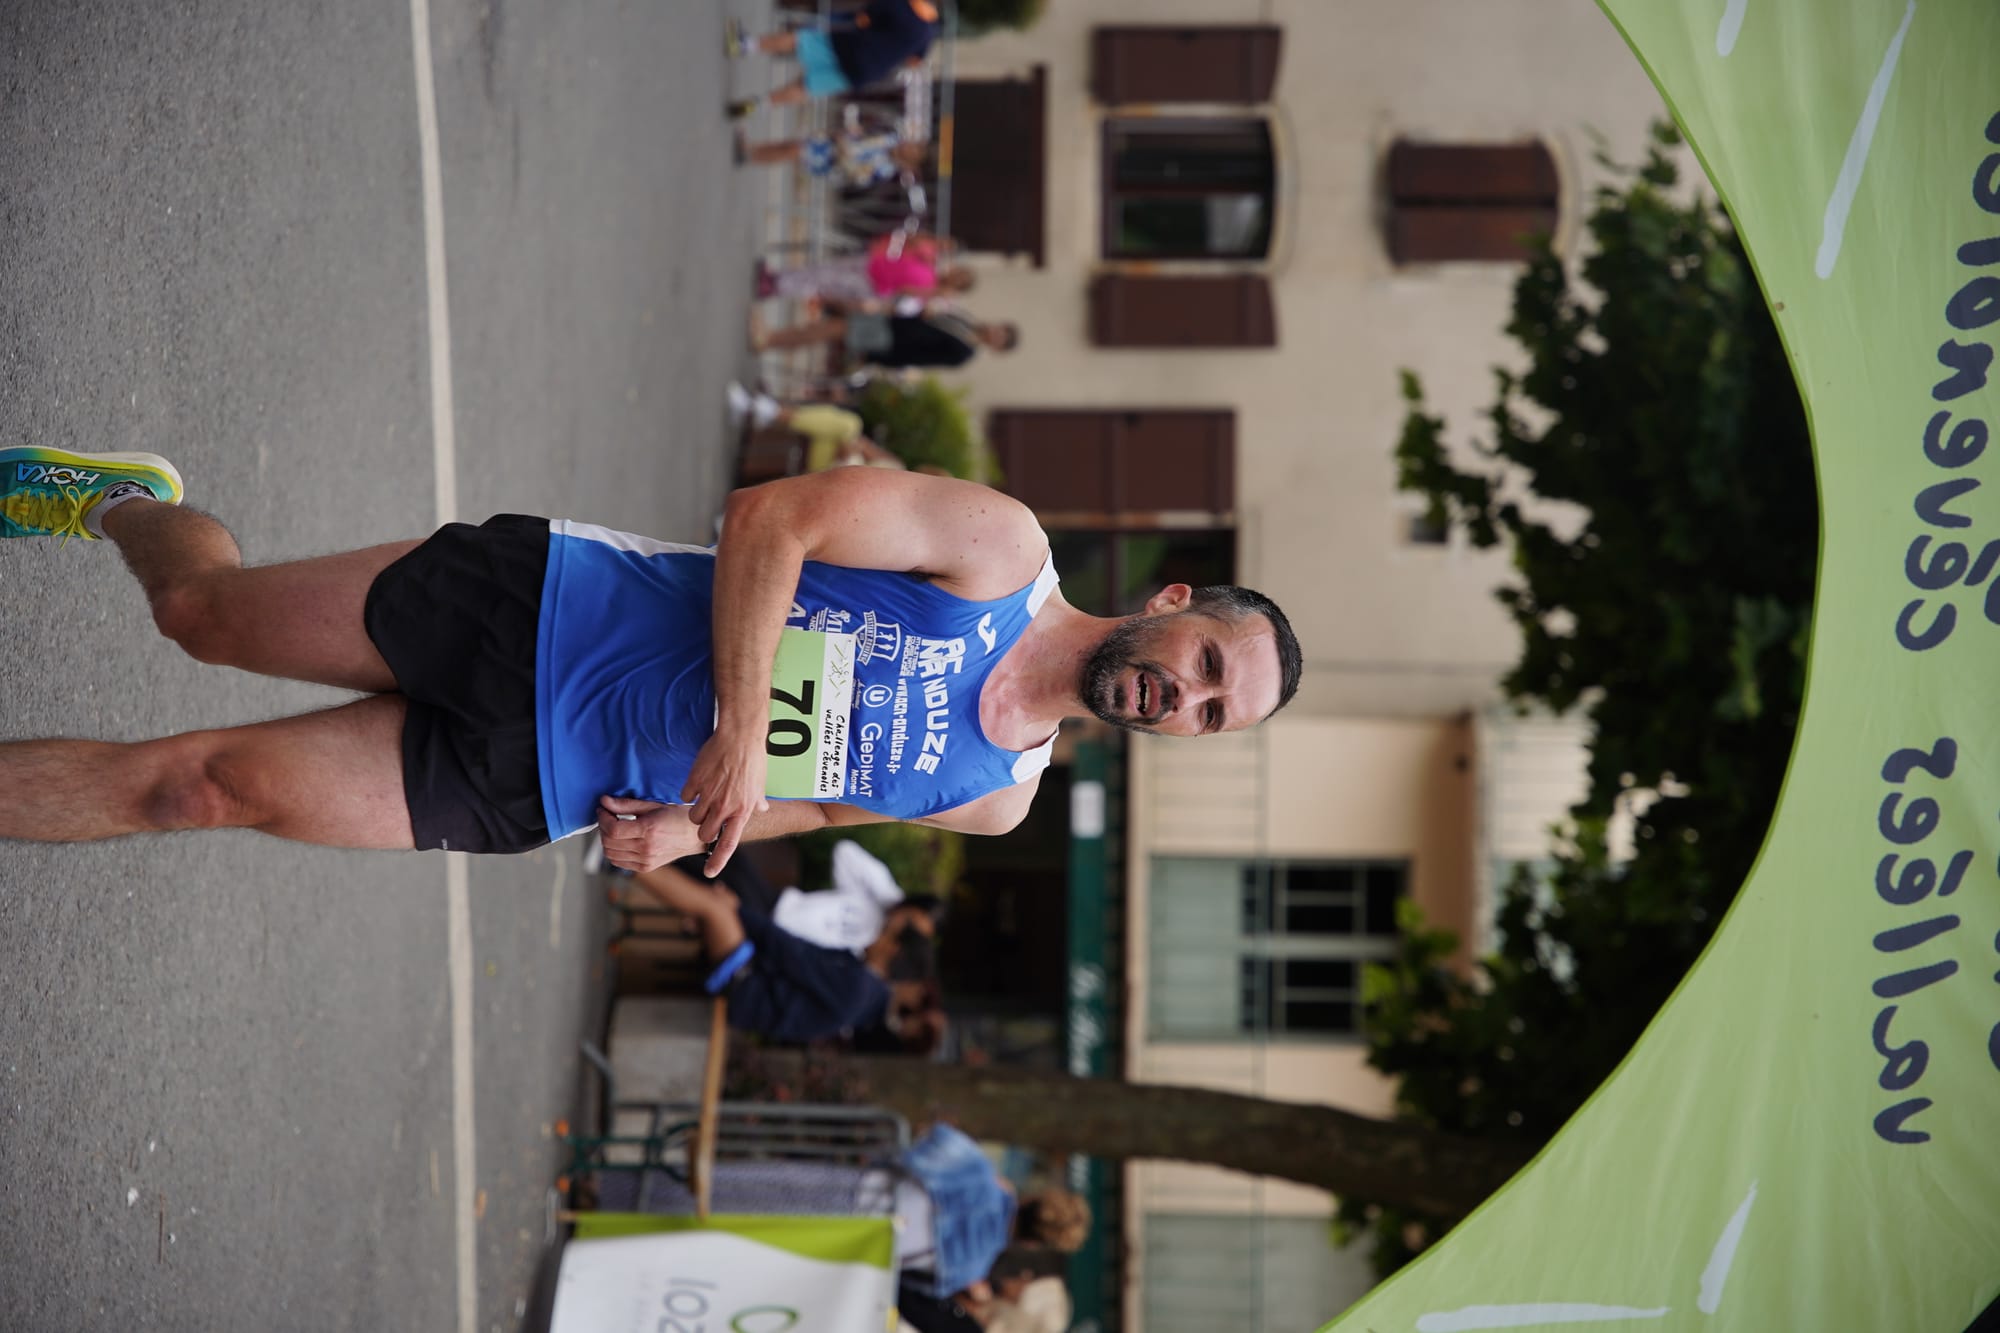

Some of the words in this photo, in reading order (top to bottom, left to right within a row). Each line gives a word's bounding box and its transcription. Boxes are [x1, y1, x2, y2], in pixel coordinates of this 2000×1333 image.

[17, 463, 100, 486] HOKA
[869, 690, 886, 702] U
[765, 680, 815, 757] 70
[823, 709, 834, 745] vallées
[830, 714, 845, 767] Challenge
[819, 751, 832, 793] cévenoles
[831, 772, 841, 788] des
[849, 769, 859, 795] Manen
